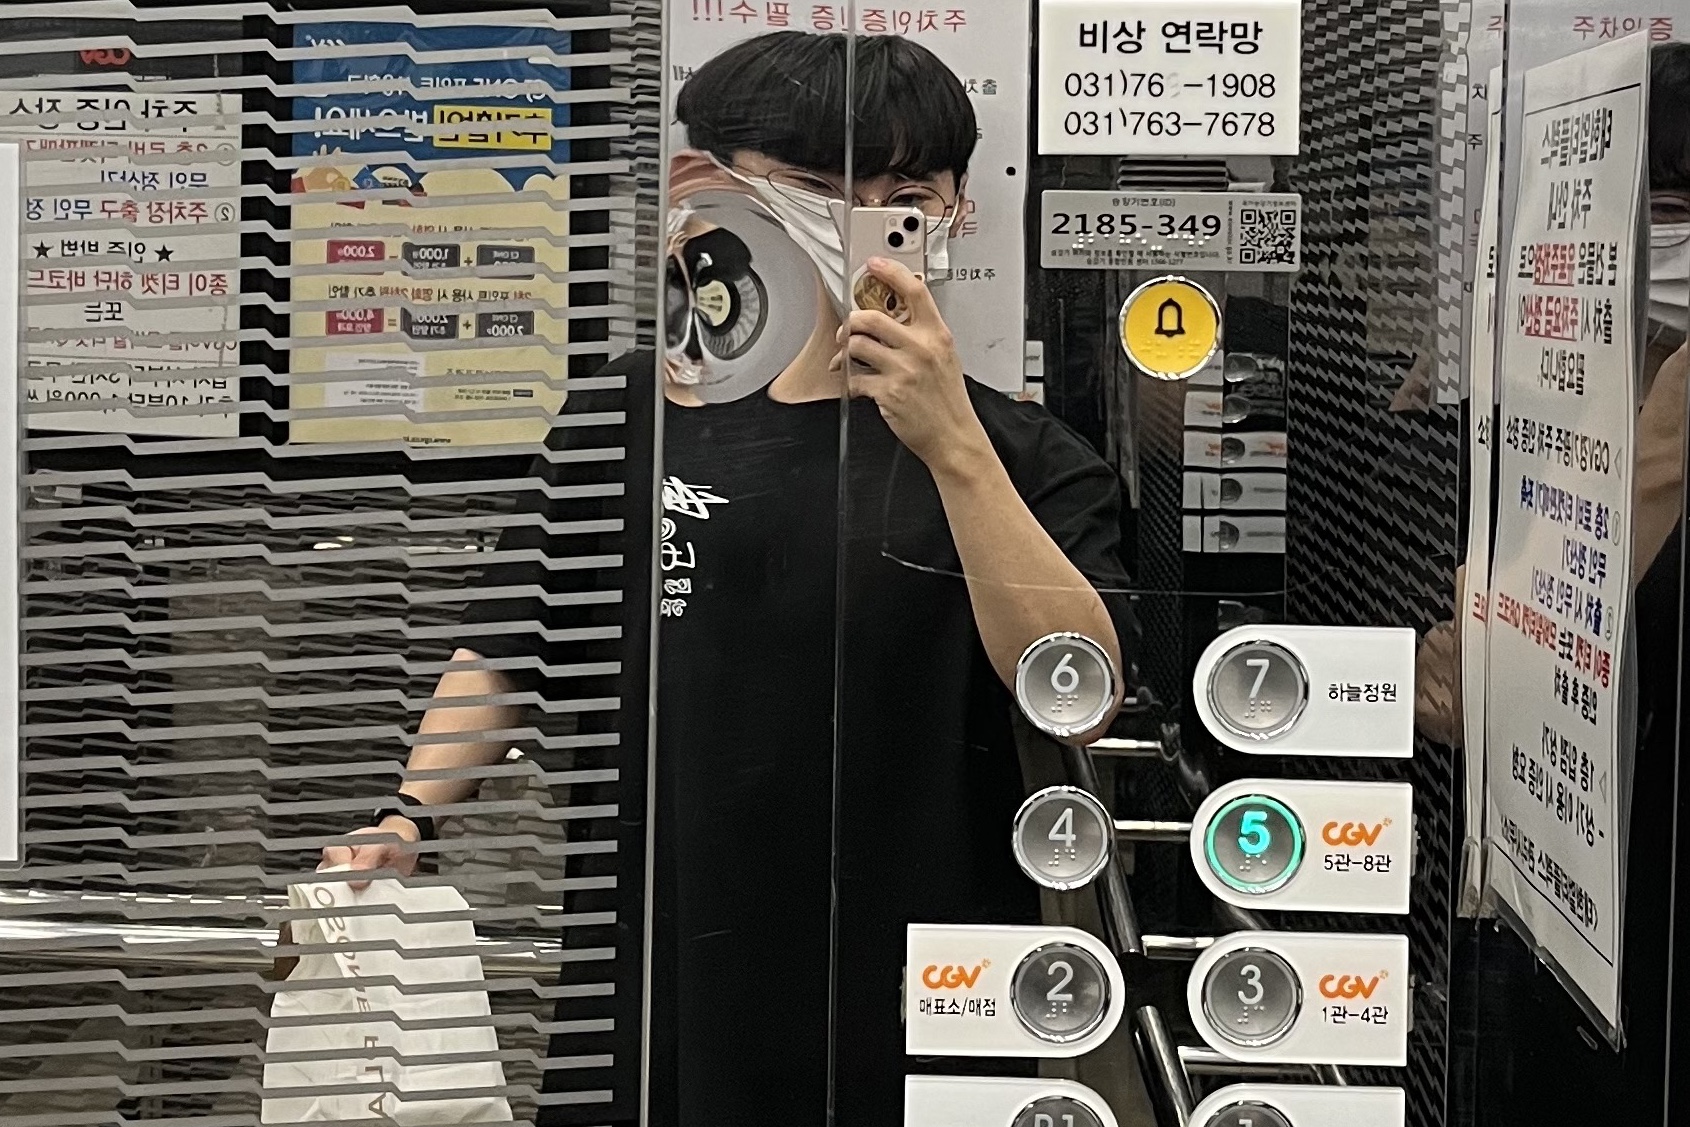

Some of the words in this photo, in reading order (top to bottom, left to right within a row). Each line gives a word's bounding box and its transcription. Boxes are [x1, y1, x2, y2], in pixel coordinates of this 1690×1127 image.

[1079, 20, 1147, 54] 비상
[1161, 20, 1264, 55] 연락망
[1064, 69, 1276, 99] 031)76-1908
[1064, 107, 1275, 137] 031)763-7678
[1051, 213, 1222, 238] 2185-349
[1050, 653, 1080, 693] 6
[1246, 658, 1270, 699] 7
[1328, 682, 1398, 703] 하늘정원
[1048, 807, 1076, 848] 4
[1238, 811, 1271, 854] 5
[1322, 821, 1383, 847] CGV
[1324, 853, 1392, 873] 5관-8관
[922, 964, 982, 989] CGV
[1046, 961, 1074, 1002] 2
[1238, 964, 1265, 1005] 3
[1318, 974, 1379, 999] CGV
[919, 997, 996, 1017] 매표소/매점
[1322, 1005, 1389, 1025] 1관-4관
